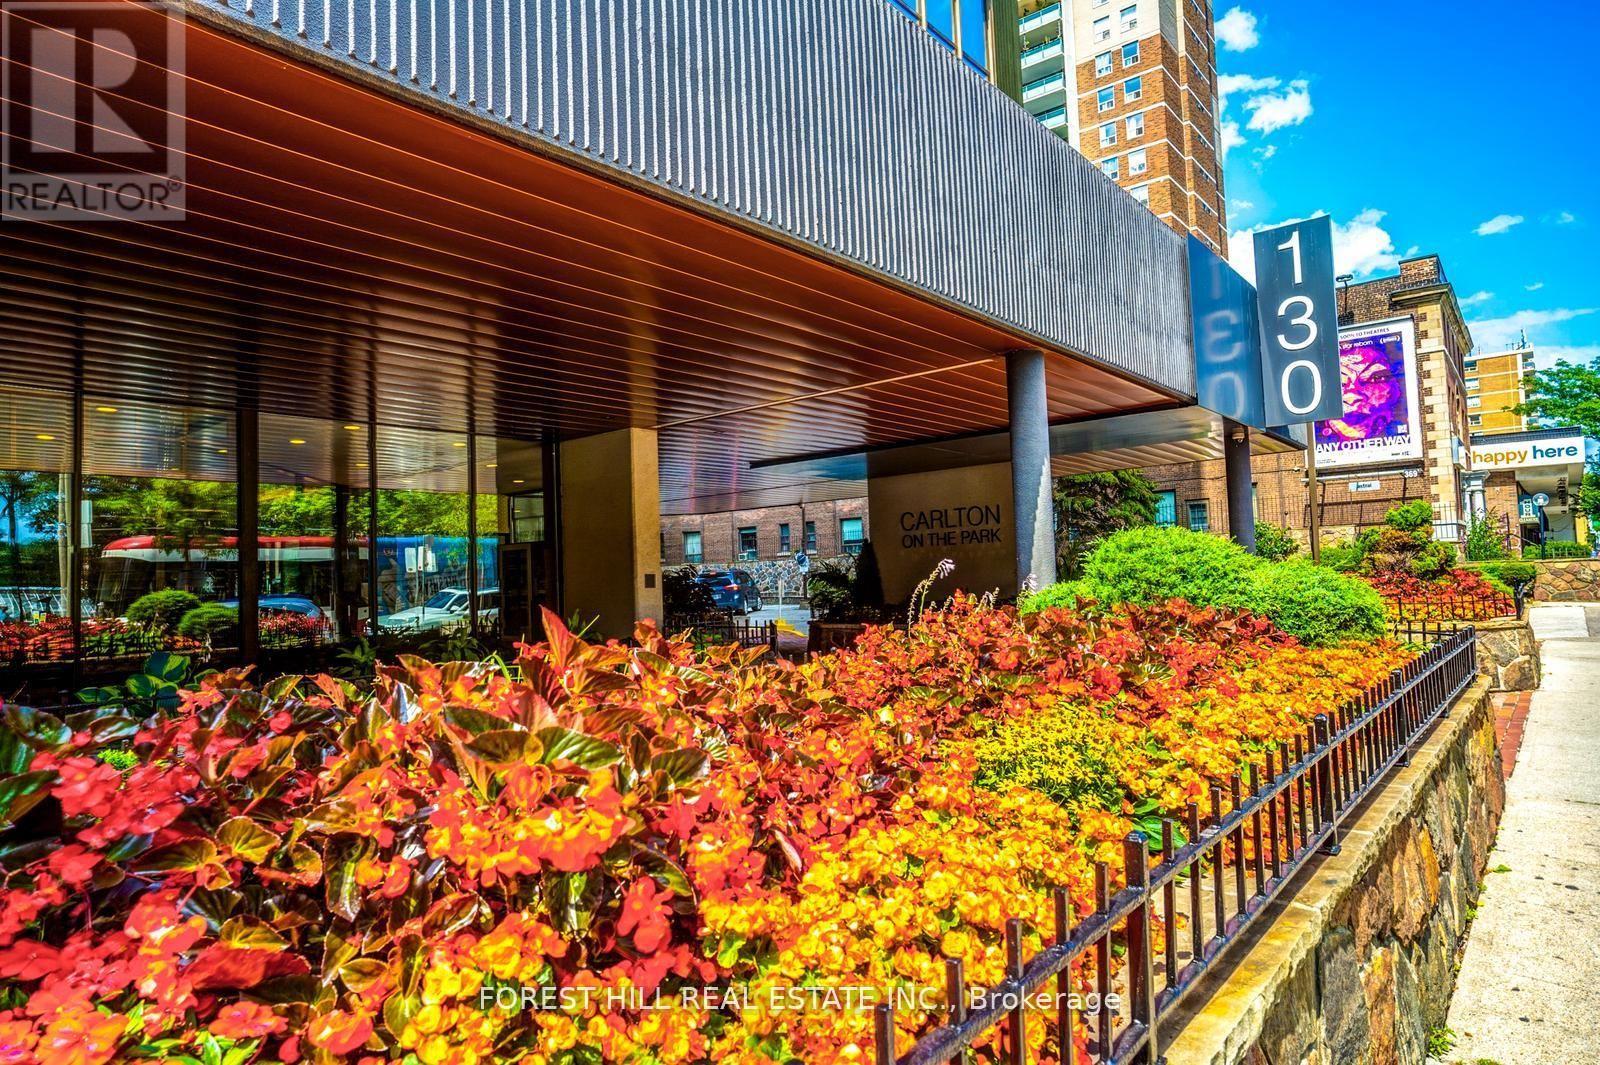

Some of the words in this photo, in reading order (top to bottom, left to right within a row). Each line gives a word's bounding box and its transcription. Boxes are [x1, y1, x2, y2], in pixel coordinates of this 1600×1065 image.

[1277, 231, 1322, 414] 130
[1316, 441, 1341, 454] ANY
[1340, 437, 1387, 451] OTHER
[1384, 434, 1411, 447] WAY
[1472, 450, 1528, 465] happy
[1532, 445, 1578, 459] here
[900, 504, 1001, 531] CARLTON
[902, 534, 924, 549] ON
[928, 531, 957, 547] THE
[961, 528, 1002, 544] PARK
